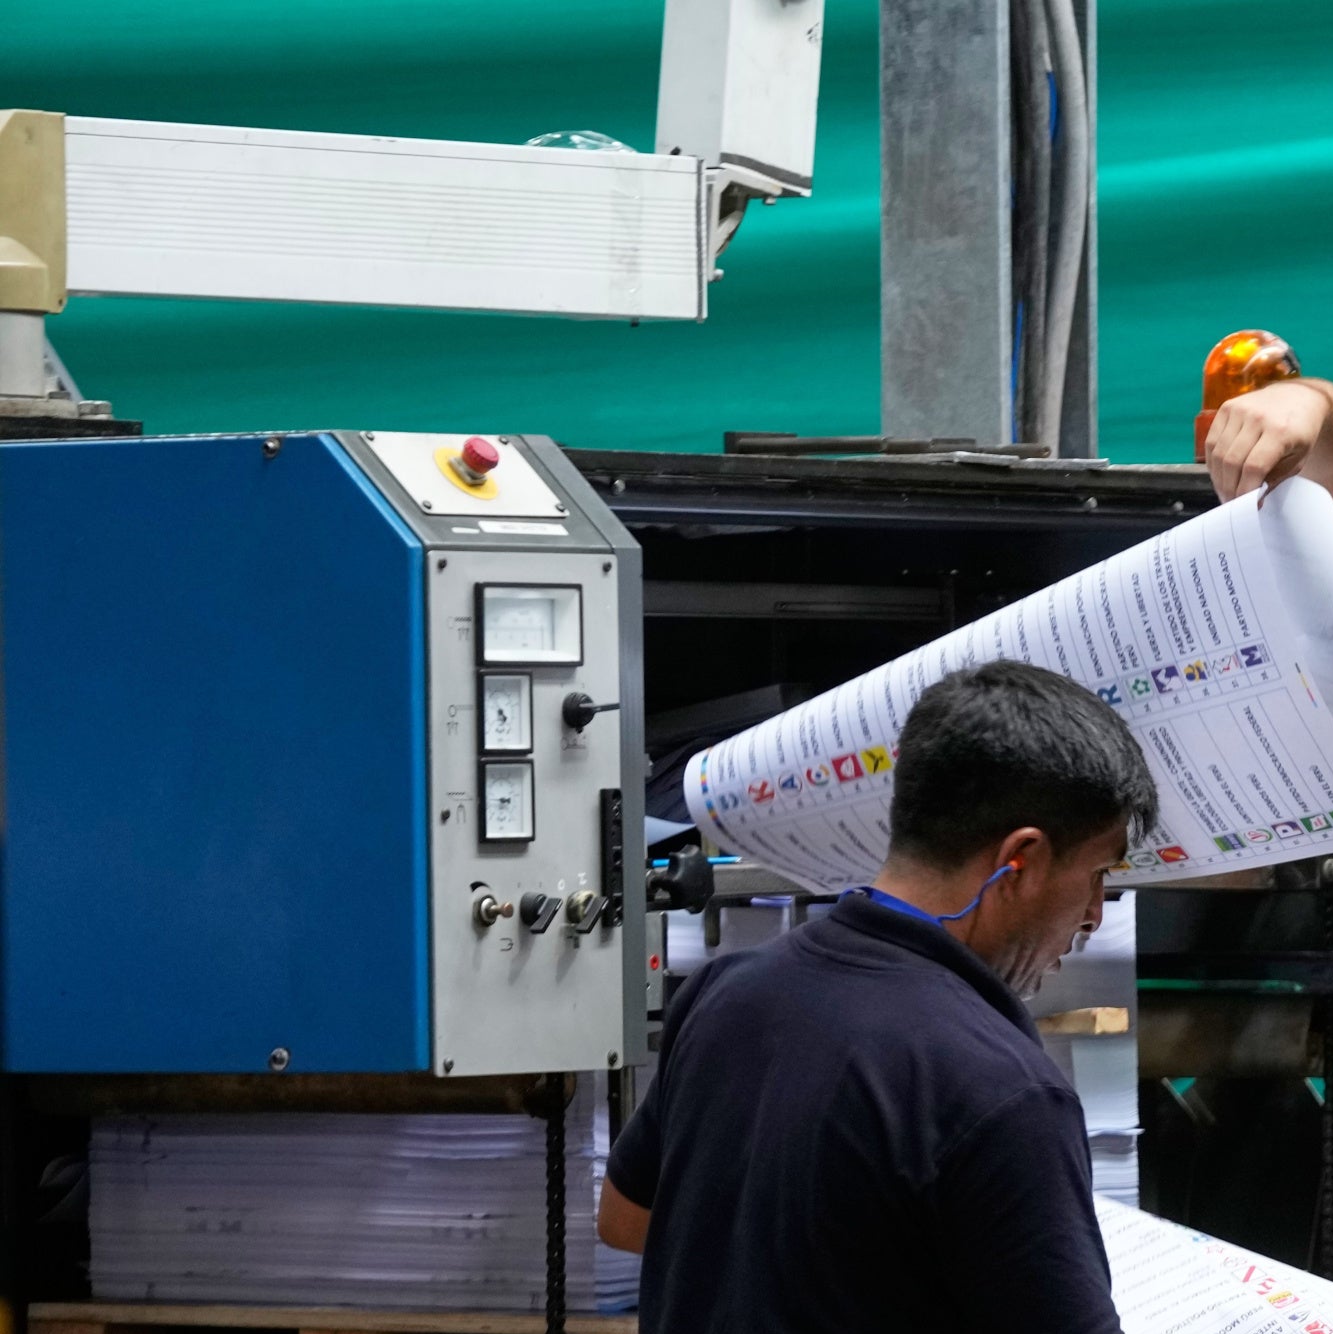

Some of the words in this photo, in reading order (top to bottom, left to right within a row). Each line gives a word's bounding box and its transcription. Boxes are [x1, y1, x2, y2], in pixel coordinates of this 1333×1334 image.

[1130, 572, 1148, 618] LIBERTAD
[1189, 556, 1208, 609] NACIONAL
[1217, 551, 1236, 596] MORADO
[1202, 608, 1222, 646] UNIDAD
[1230, 596, 1251, 638] PARTIDO
[1144, 625, 1163, 662] FUERZA
